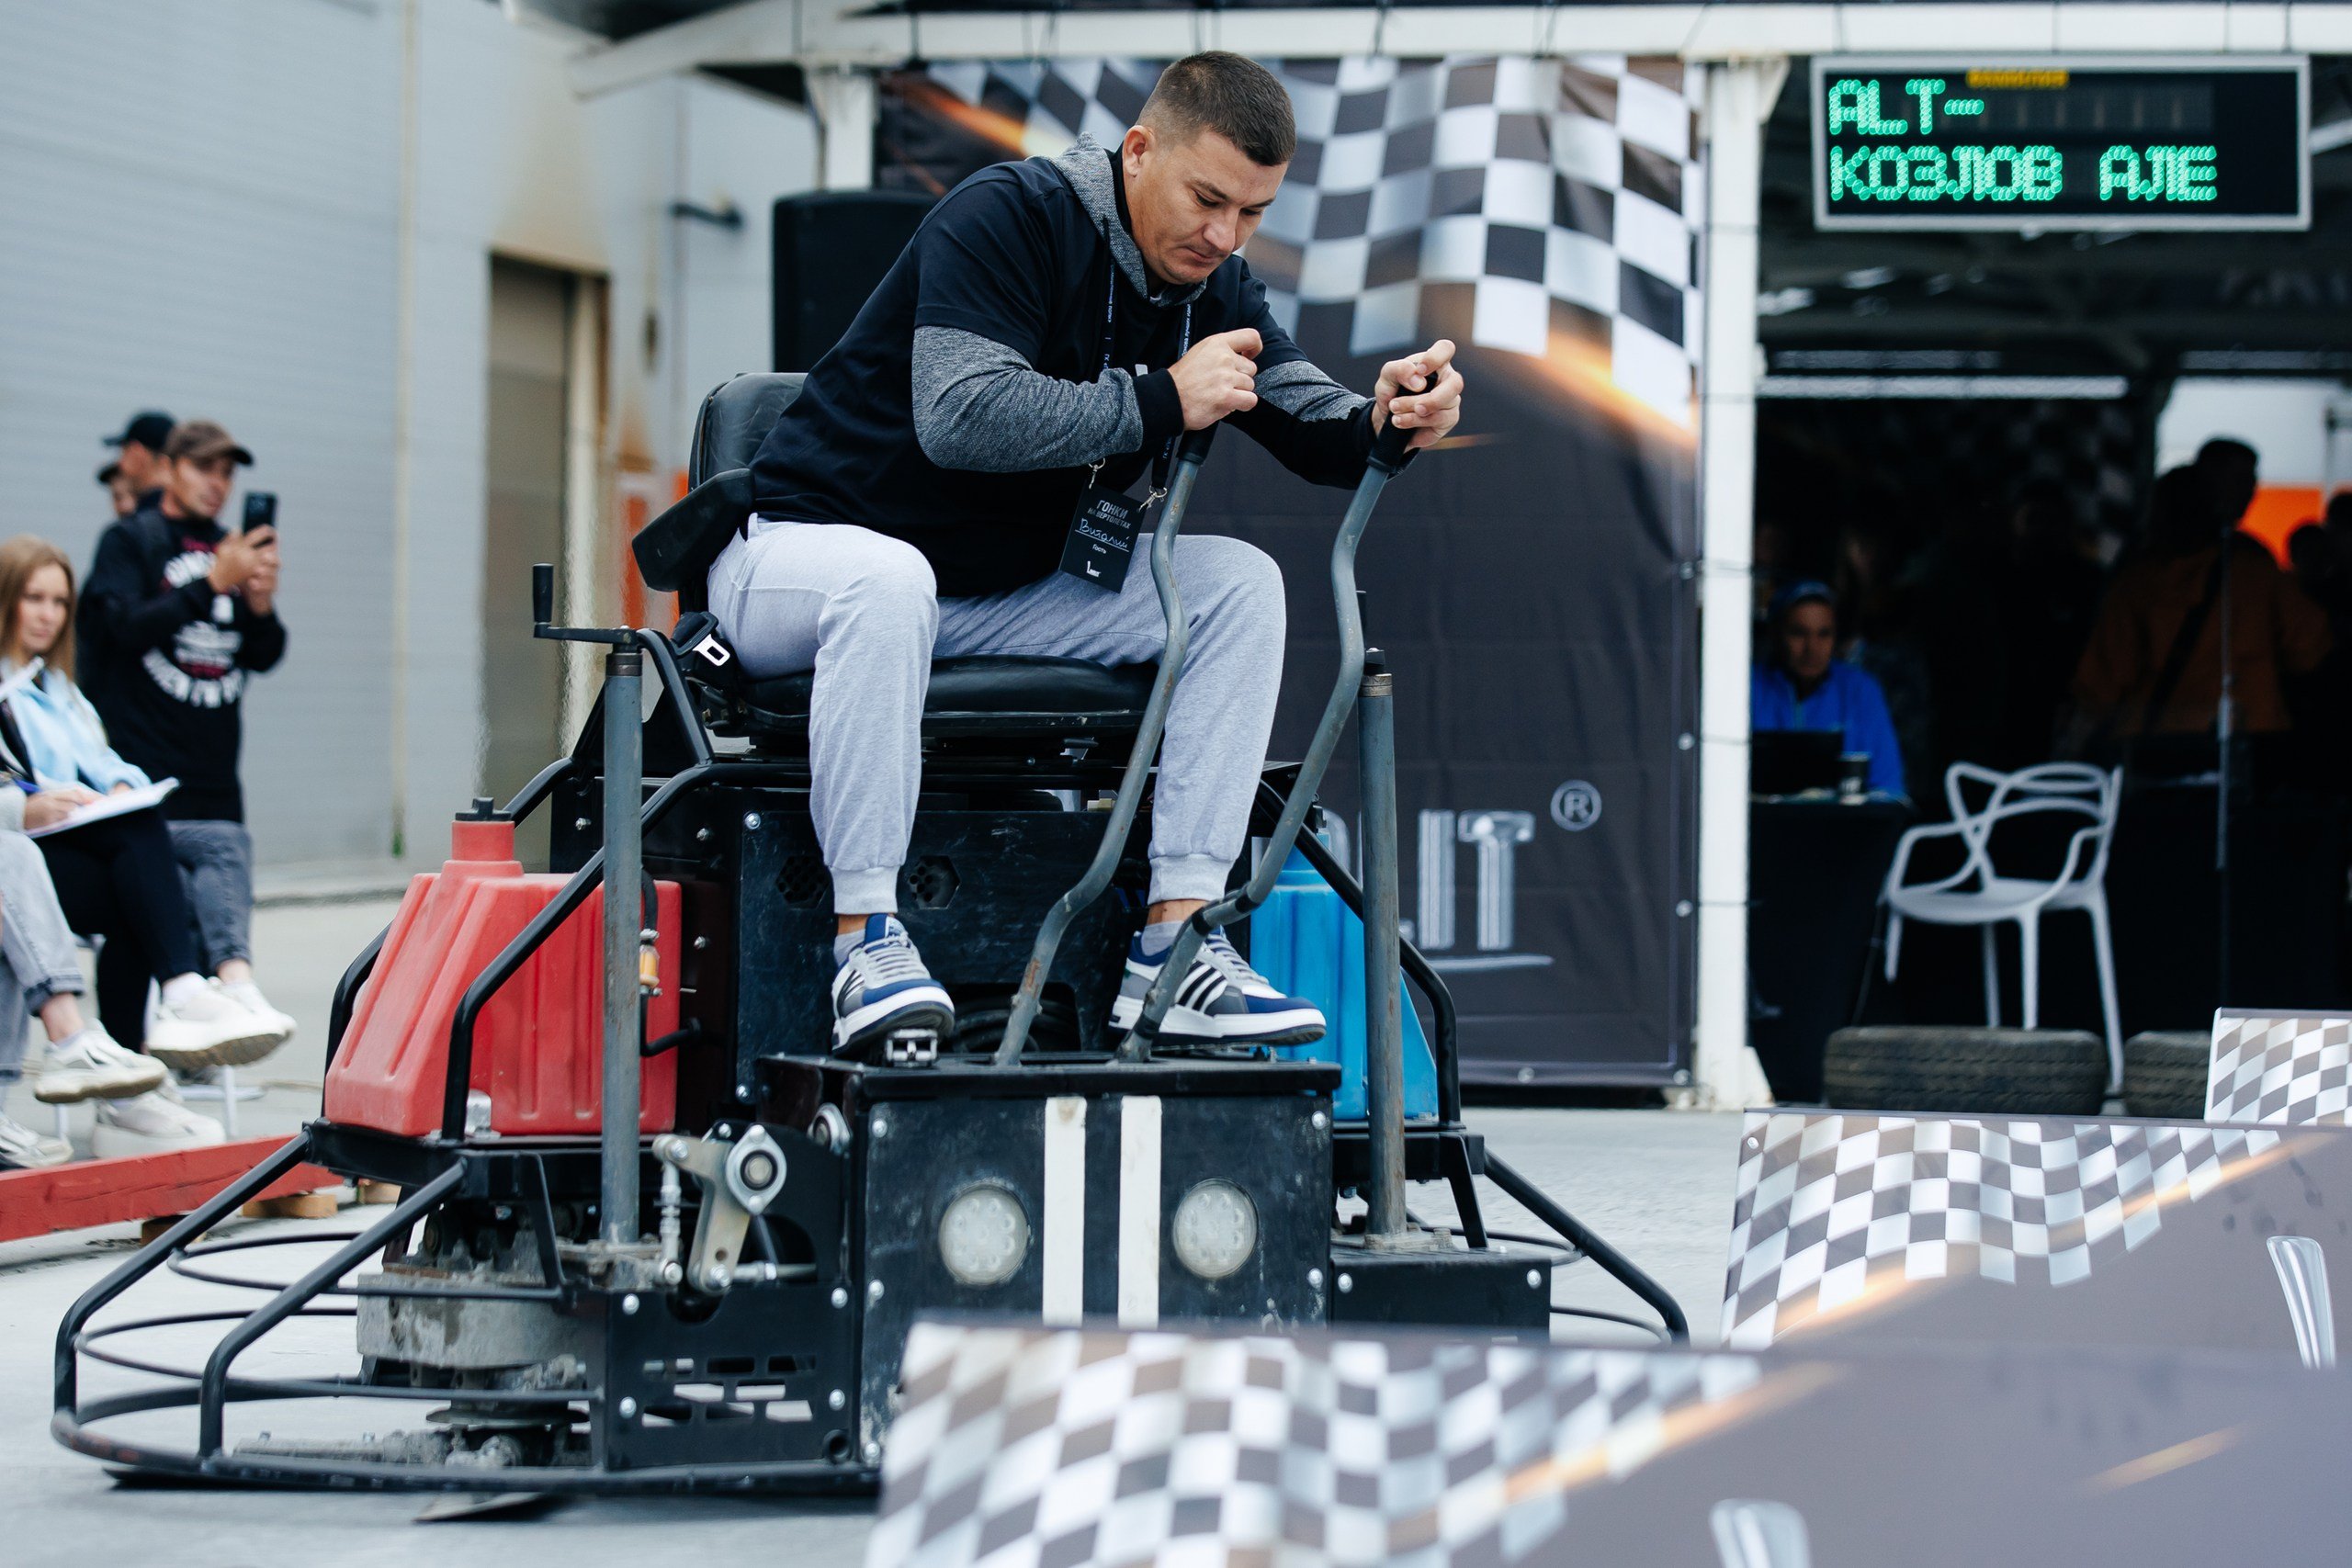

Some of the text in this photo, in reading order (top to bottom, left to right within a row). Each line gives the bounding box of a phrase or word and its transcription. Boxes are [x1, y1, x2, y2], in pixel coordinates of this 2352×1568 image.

[1830, 145, 2063, 201] КОЗЛОВ
[1096, 500, 1128, 519] ГОНКИ
[1091, 544, 1107, 555] Гость
